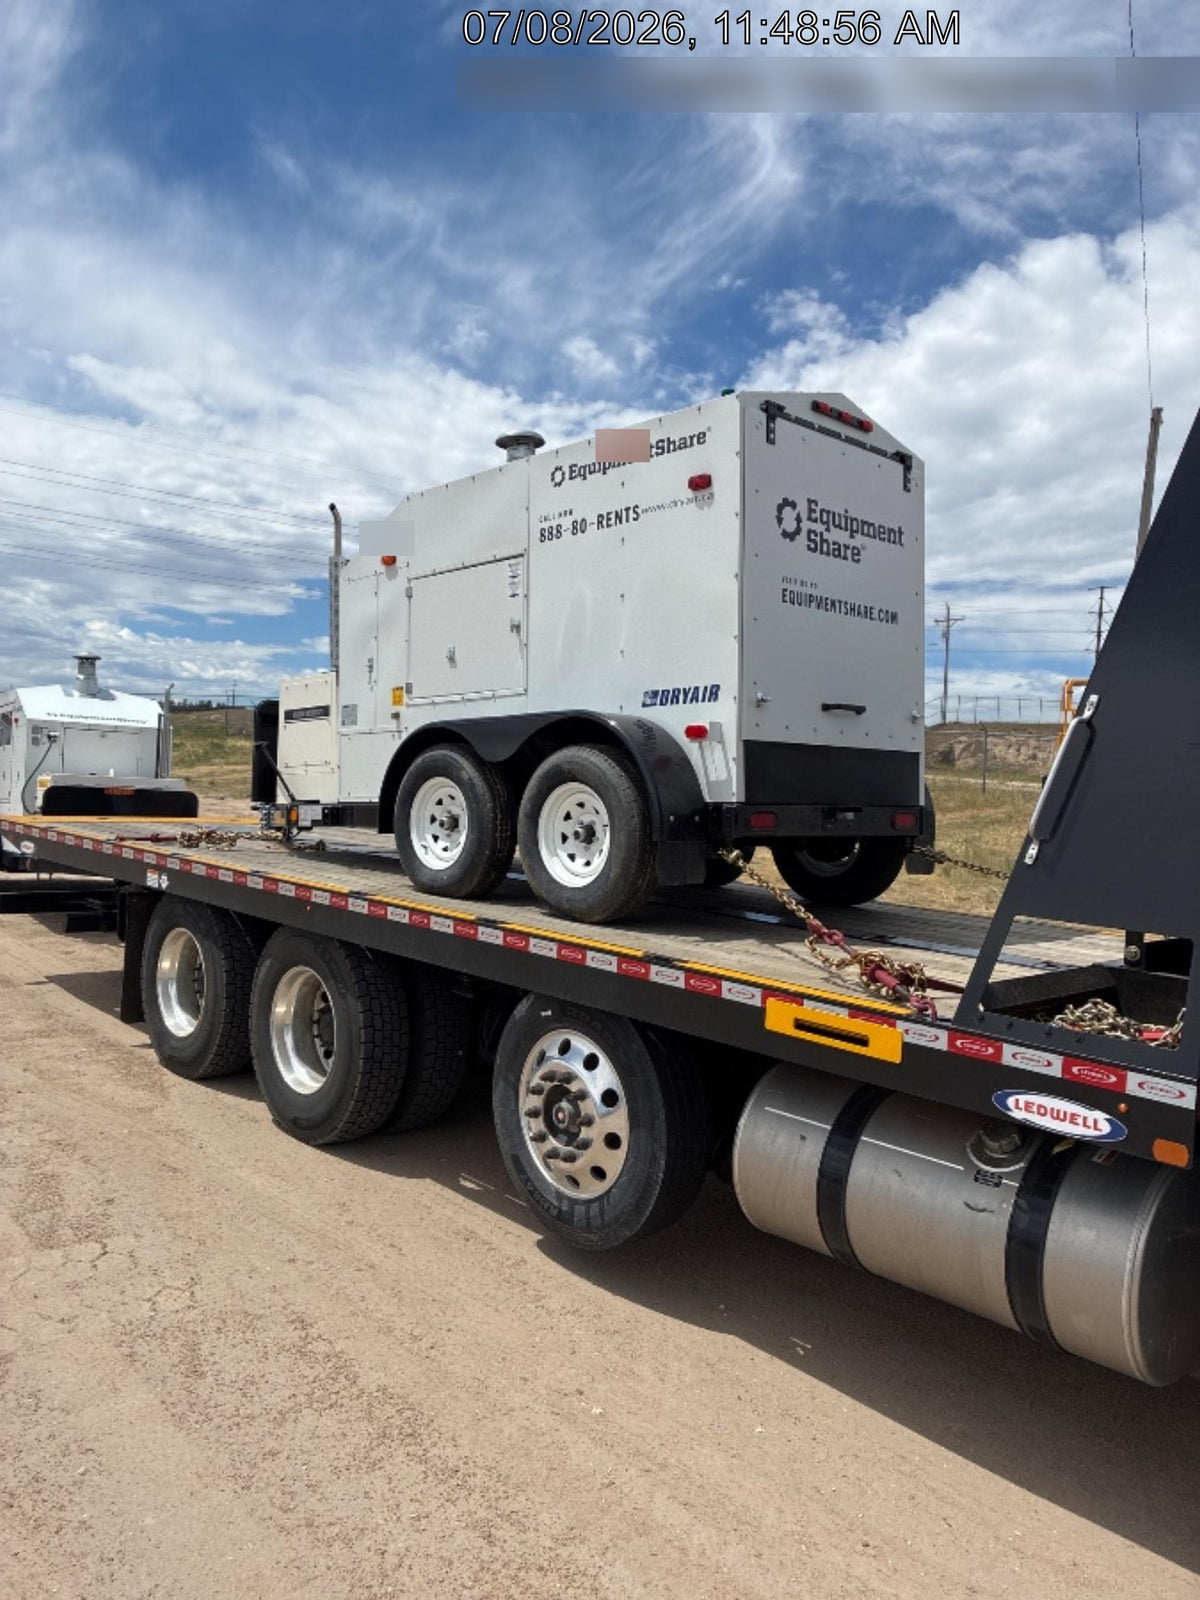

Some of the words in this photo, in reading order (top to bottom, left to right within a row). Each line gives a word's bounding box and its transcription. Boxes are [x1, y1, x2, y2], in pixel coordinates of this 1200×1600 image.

[539, 505, 640, 543] 888-80-RENTS
[806, 497, 905, 548] Equipment
[806, 528, 862, 564] Share
[781, 588, 899, 625] EQUIPMENTSHARE.COM
[659, 684, 721, 707] DRYAIR
[1013, 1097, 1104, 1133] LEDWELL
